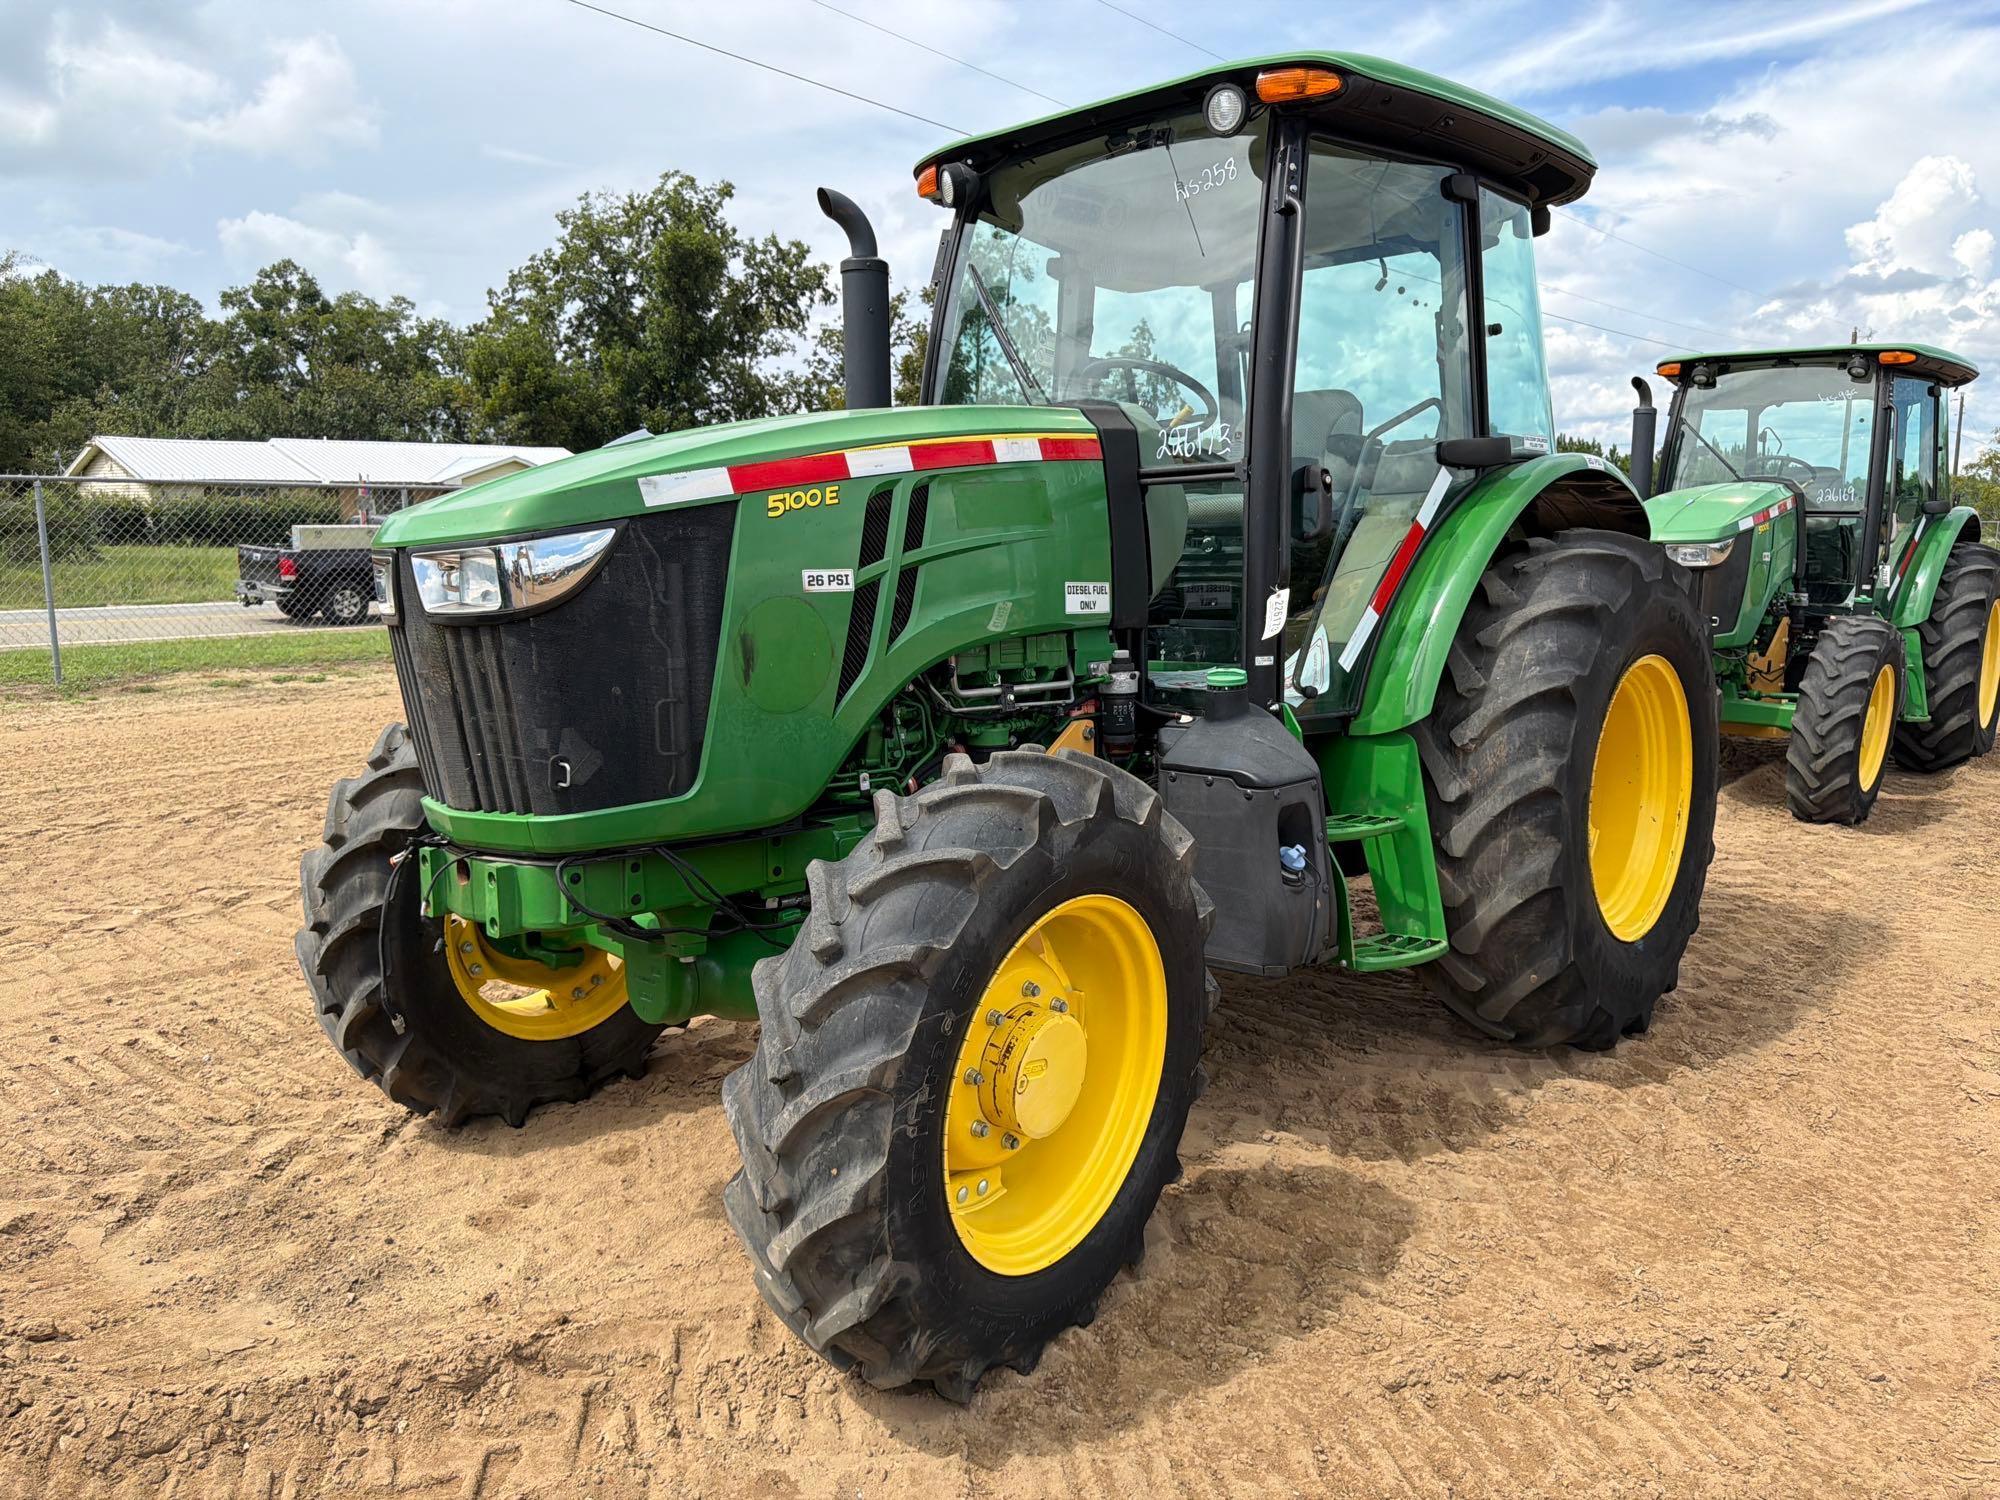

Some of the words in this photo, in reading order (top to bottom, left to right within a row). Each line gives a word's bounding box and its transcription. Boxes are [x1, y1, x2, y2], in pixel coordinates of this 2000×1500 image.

[1816, 485, 1855, 504] 226169
[767, 488, 822, 518] 5100
[825, 485, 840, 506] E
[807, 574, 824, 586] 26
[828, 574, 850, 586] PSI
[1067, 585, 1092, 595] DIESEL
[1092, 585, 1108, 595] FUEL
[1080, 600, 1097, 610] ONLY
